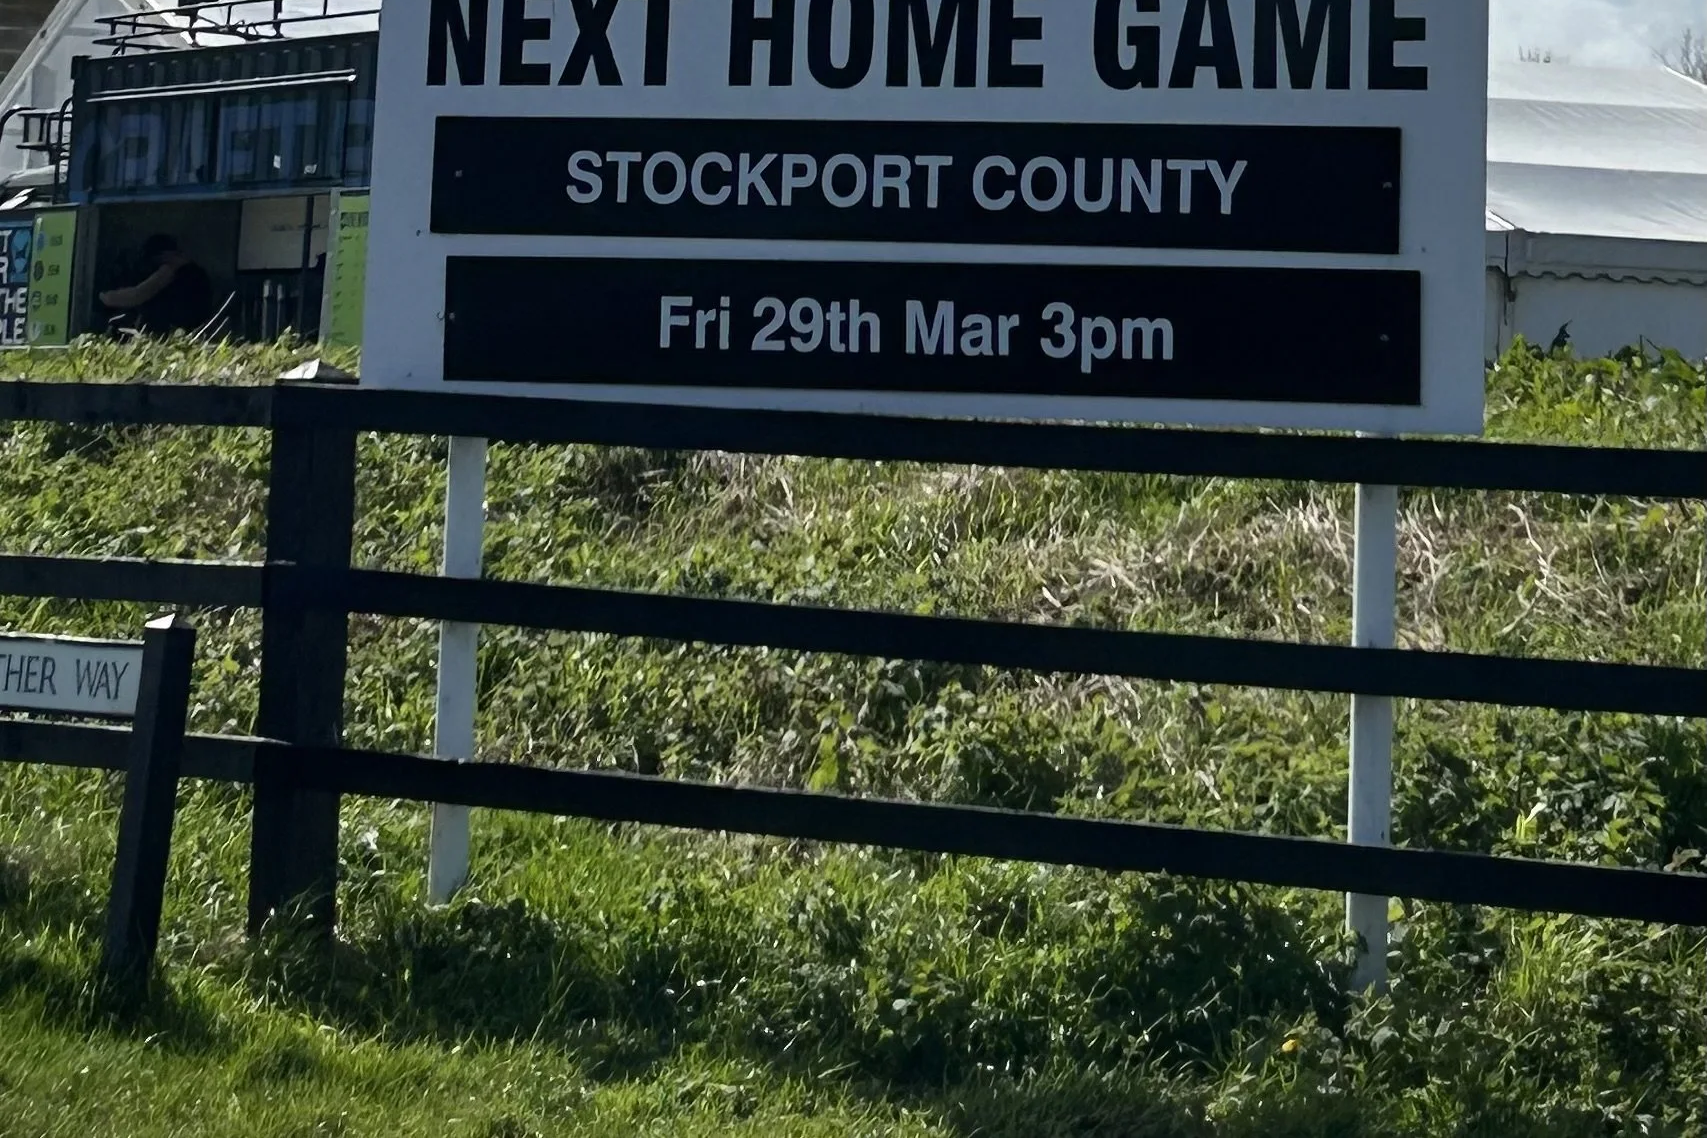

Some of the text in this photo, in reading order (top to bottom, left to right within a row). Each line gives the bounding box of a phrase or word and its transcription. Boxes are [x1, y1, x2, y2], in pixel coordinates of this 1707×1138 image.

[566, 150, 1248, 215] STOCKPORT COUNTY
[659, 295, 1174, 374] Fri 29th Mar 3pm
[75, 658, 130, 700] WAY
